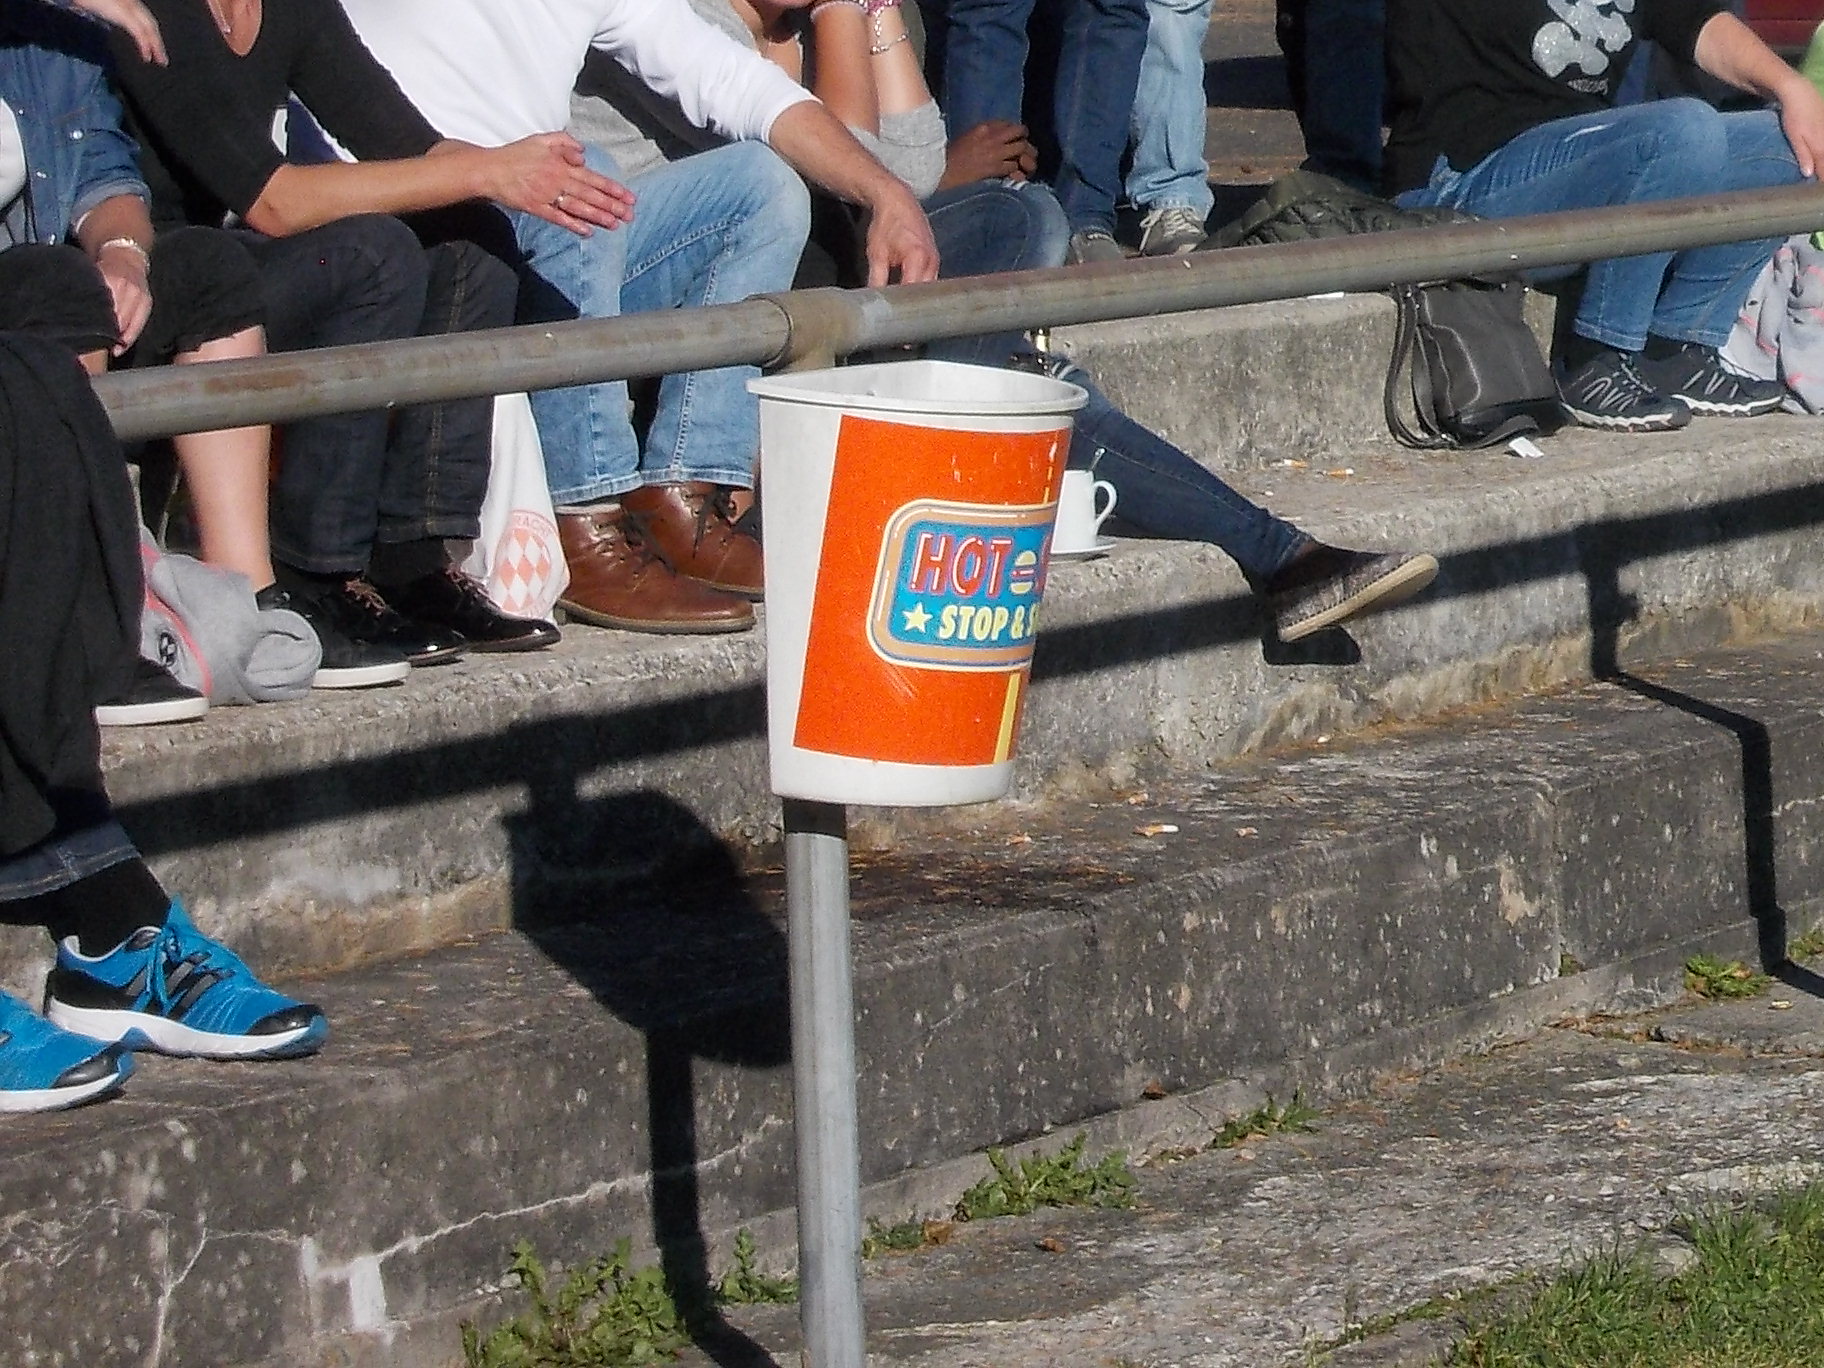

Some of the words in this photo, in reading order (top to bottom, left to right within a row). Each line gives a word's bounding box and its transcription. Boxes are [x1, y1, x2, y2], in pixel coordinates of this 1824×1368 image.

[910, 530, 1014, 597] HOT
[939, 603, 1010, 641] STOP
[1010, 604, 1025, 640] &
